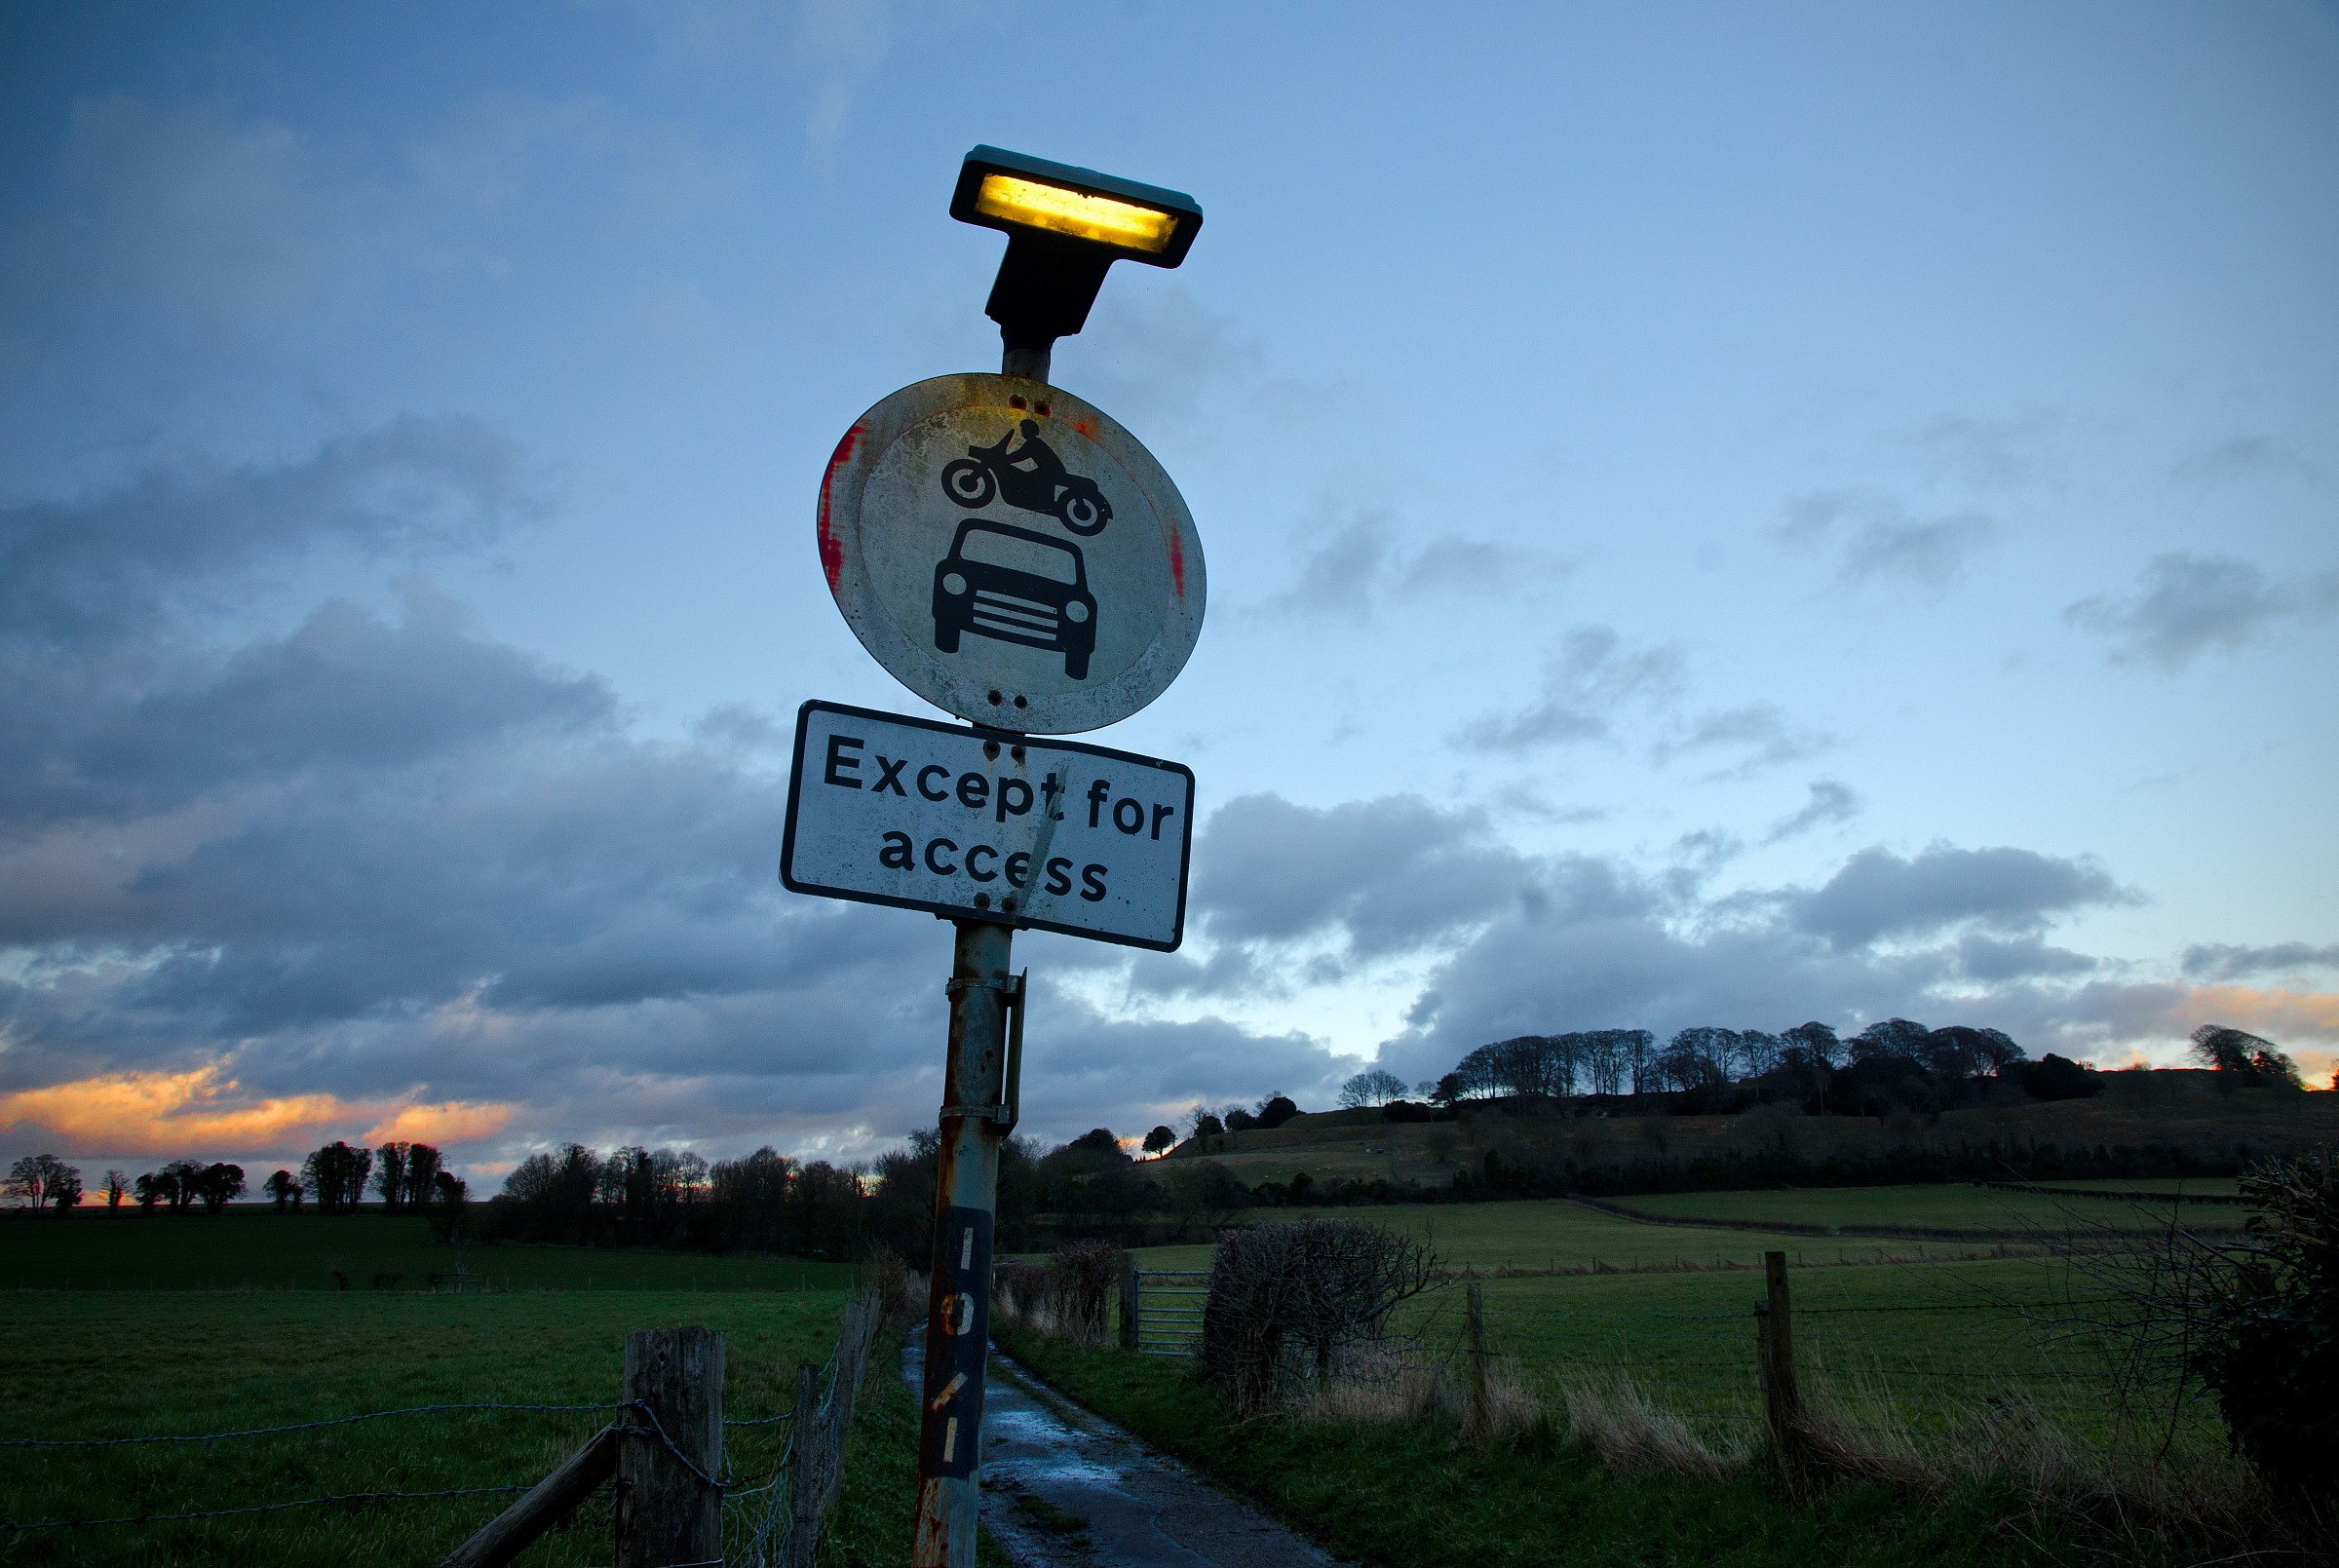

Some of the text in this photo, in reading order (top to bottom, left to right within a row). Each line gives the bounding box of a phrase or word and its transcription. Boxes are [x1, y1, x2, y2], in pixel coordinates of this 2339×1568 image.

[824, 734, 1174, 840] Except for
[879, 830, 1108, 901] access
